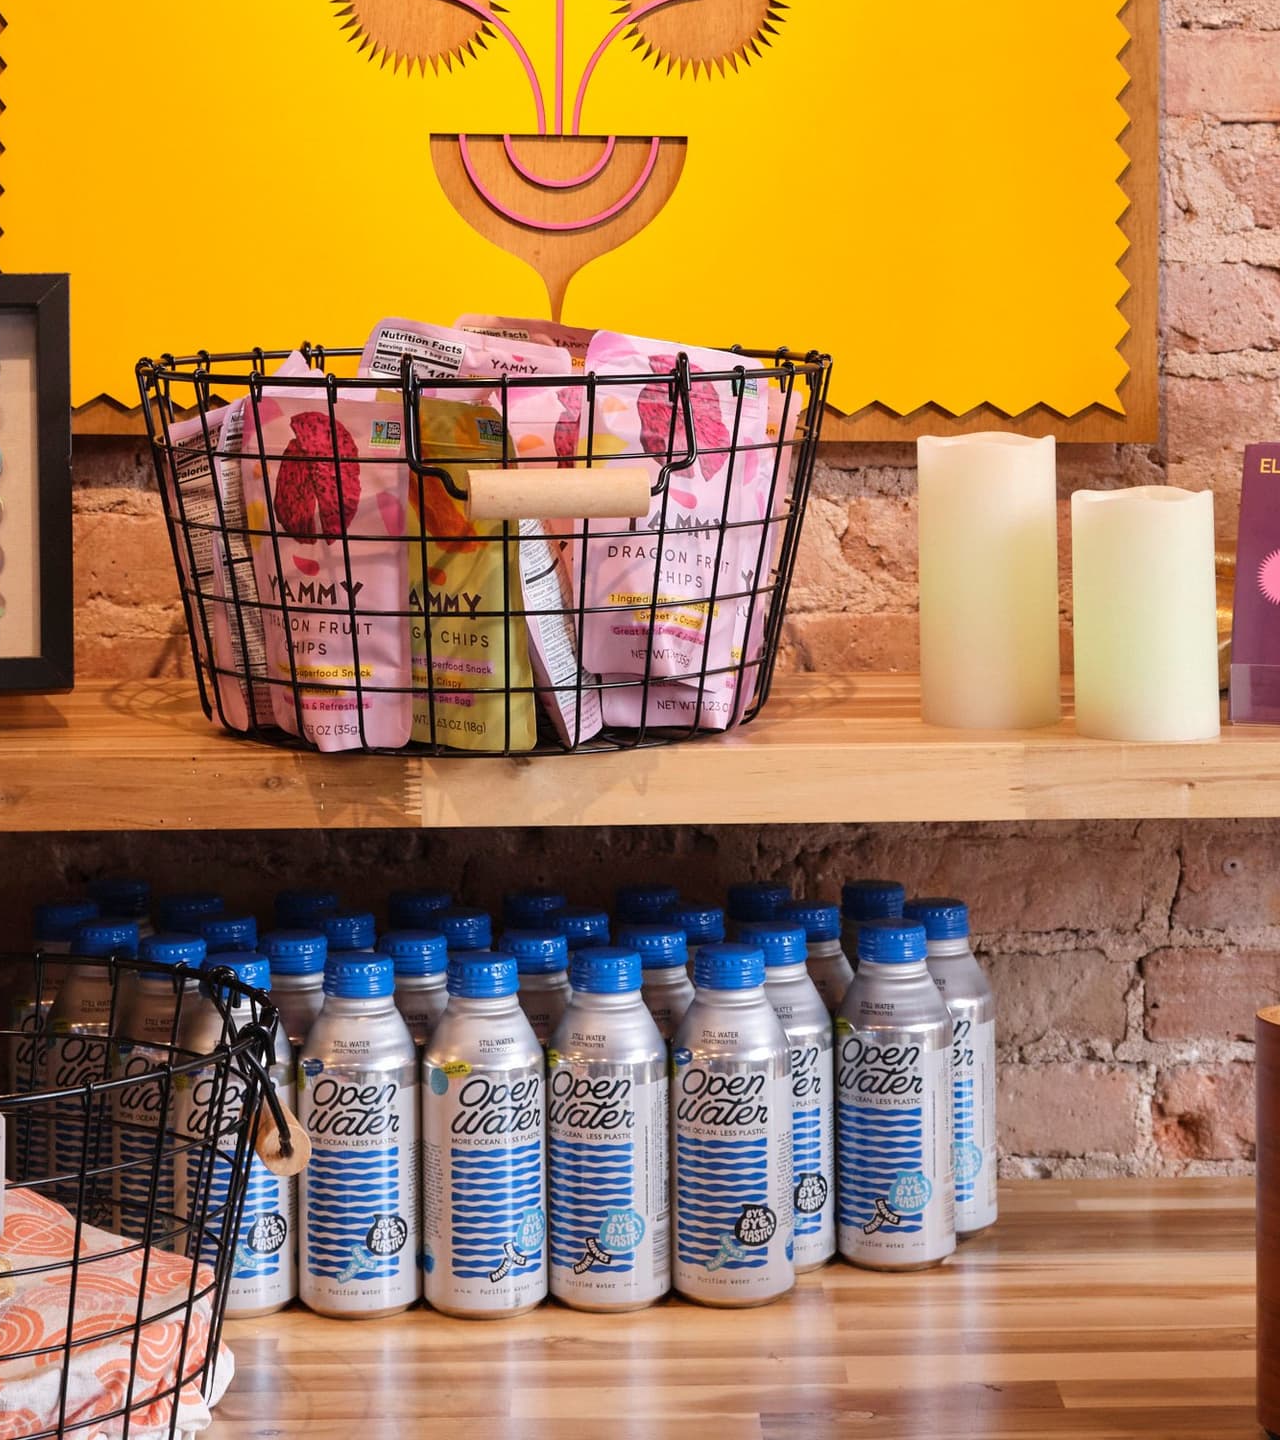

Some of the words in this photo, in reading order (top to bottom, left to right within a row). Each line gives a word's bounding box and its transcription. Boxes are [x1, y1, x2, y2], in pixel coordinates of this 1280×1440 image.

[380, 330, 429, 347] Nutrition
[432, 339, 464, 356] Facts
[490, 359, 539, 375] YAMMY
[440, 630, 490, 649] CHIPS
[841, 1036, 920, 1066] Open
[680, 1068, 767, 1098] Open
